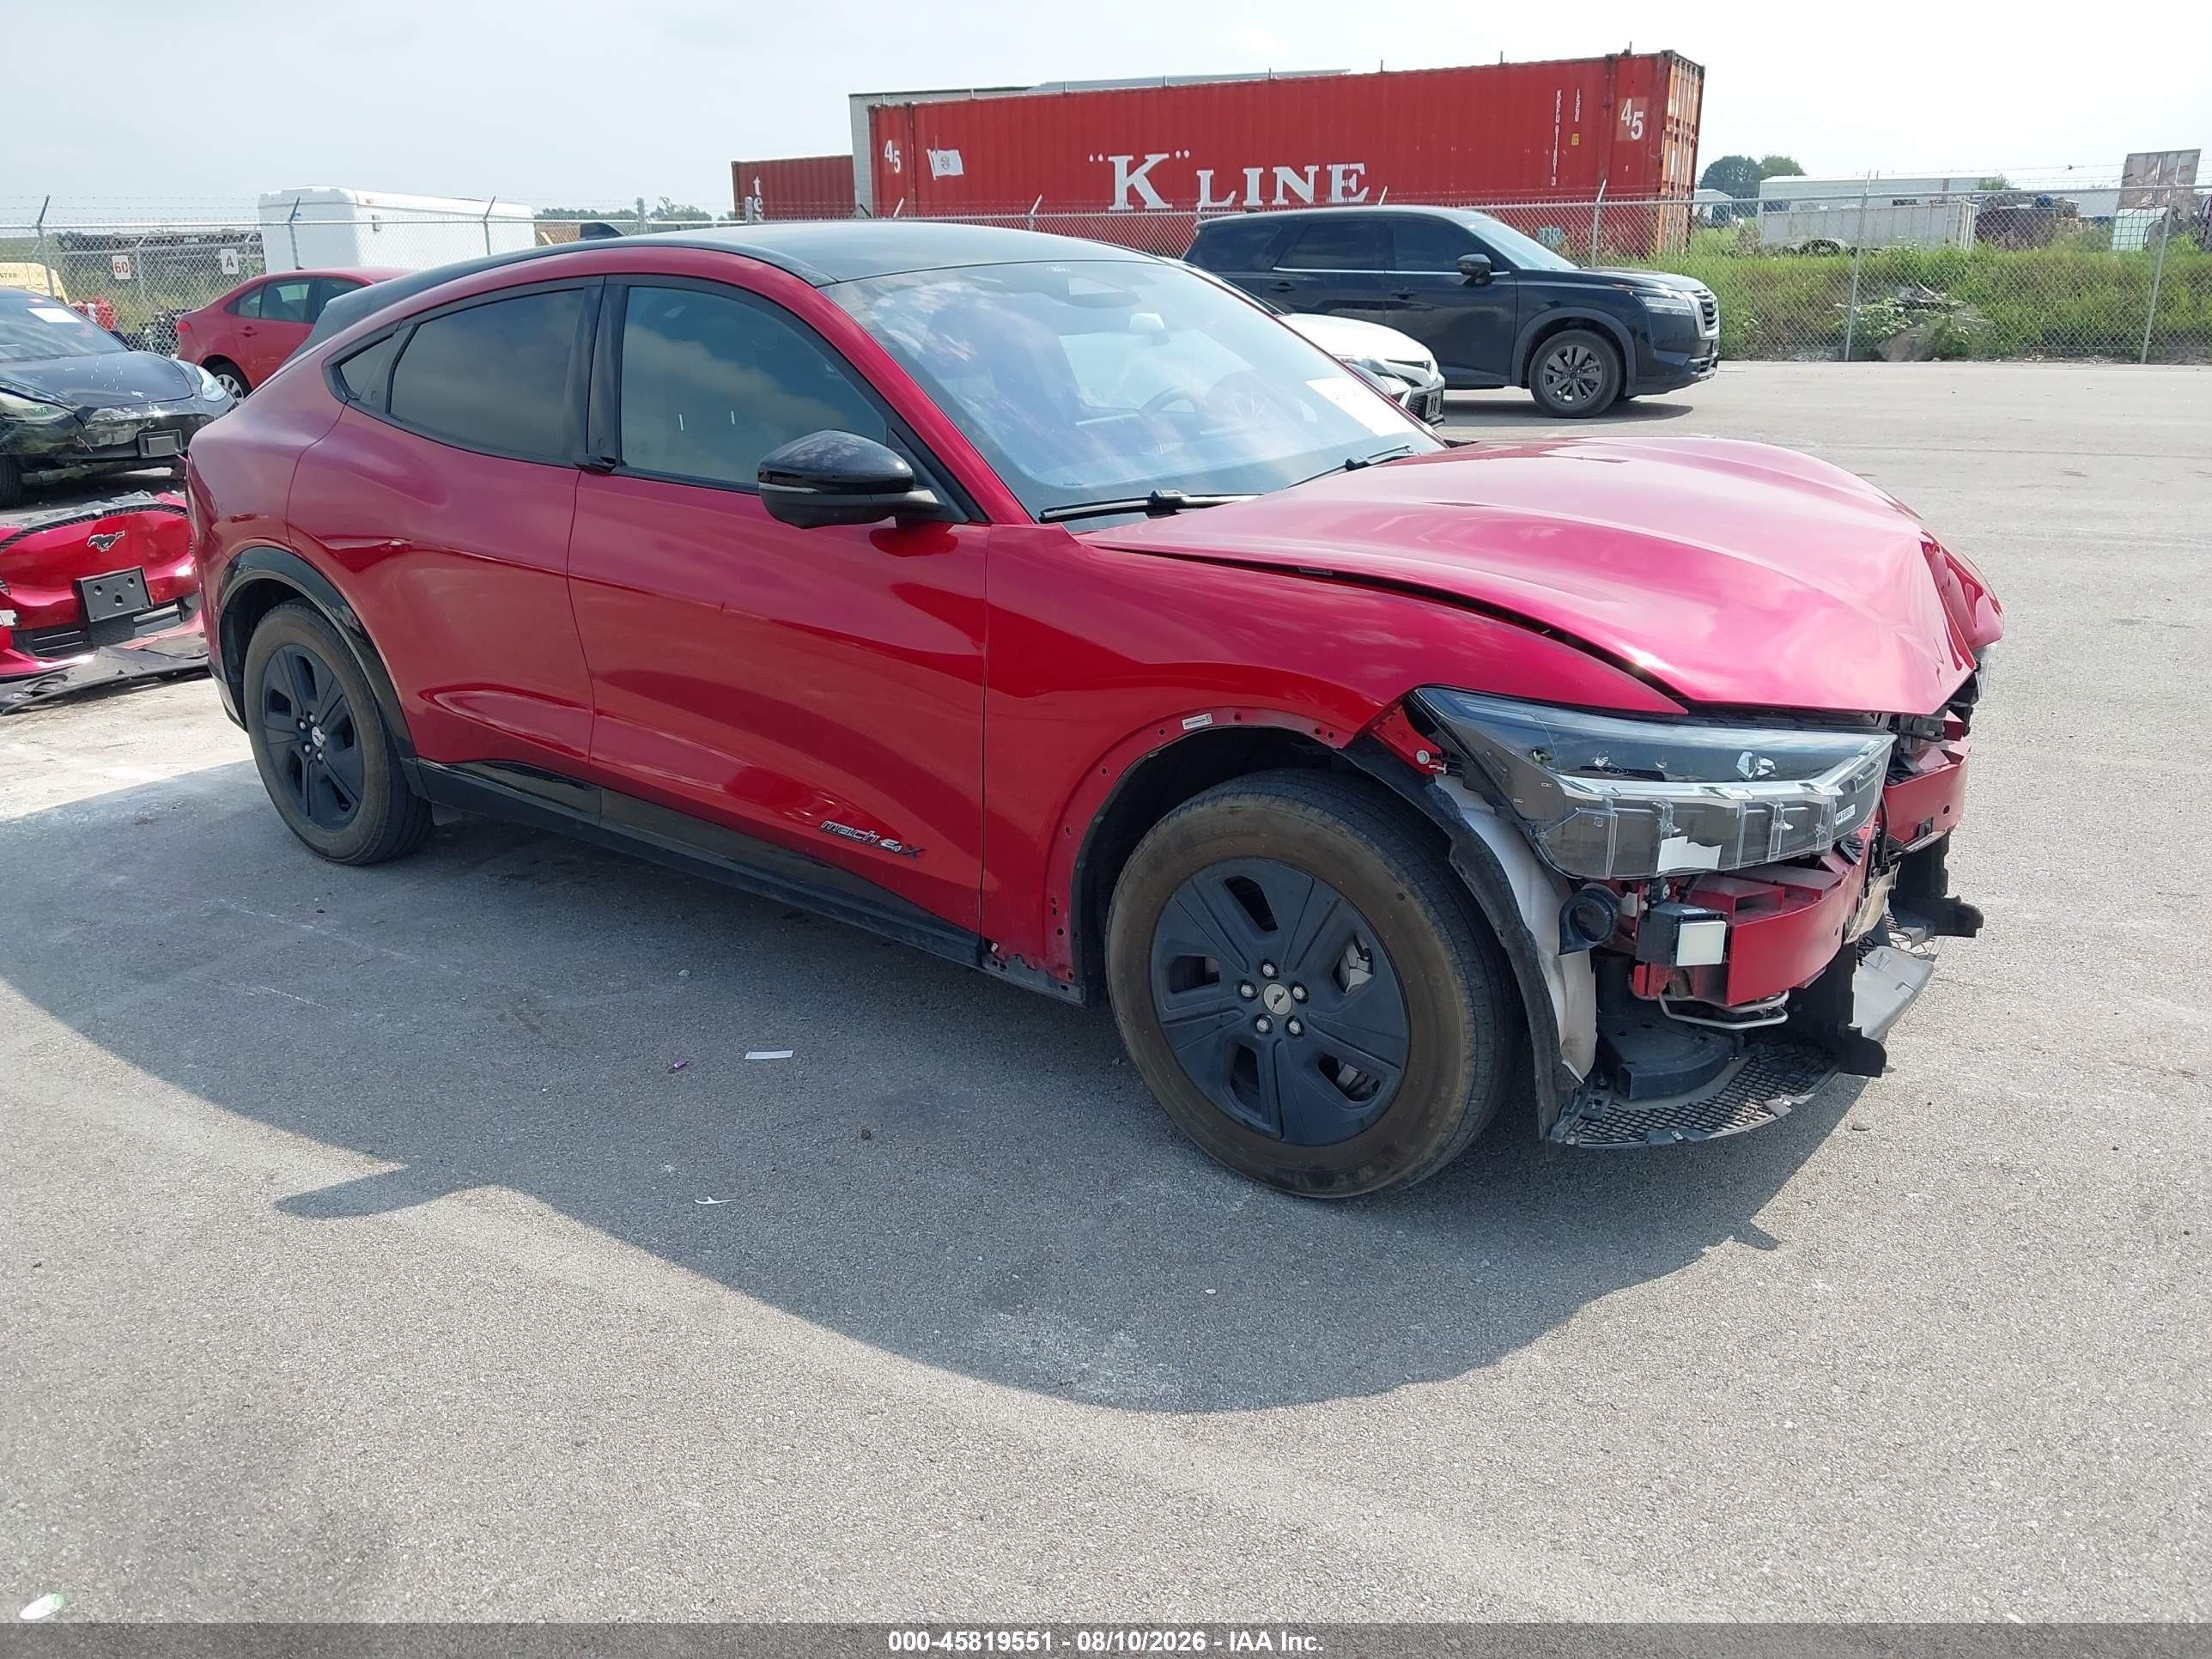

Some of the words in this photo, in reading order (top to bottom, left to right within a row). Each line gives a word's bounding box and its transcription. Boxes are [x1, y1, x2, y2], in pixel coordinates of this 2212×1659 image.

[1620, 98, 1644, 140] 45
[884, 139, 902, 174] 45
[1196, 162, 1370, 208] LINE
[114, 261, 130, 274] 60
[226, 255, 234, 268] A
[821, 820, 880, 843] mach
